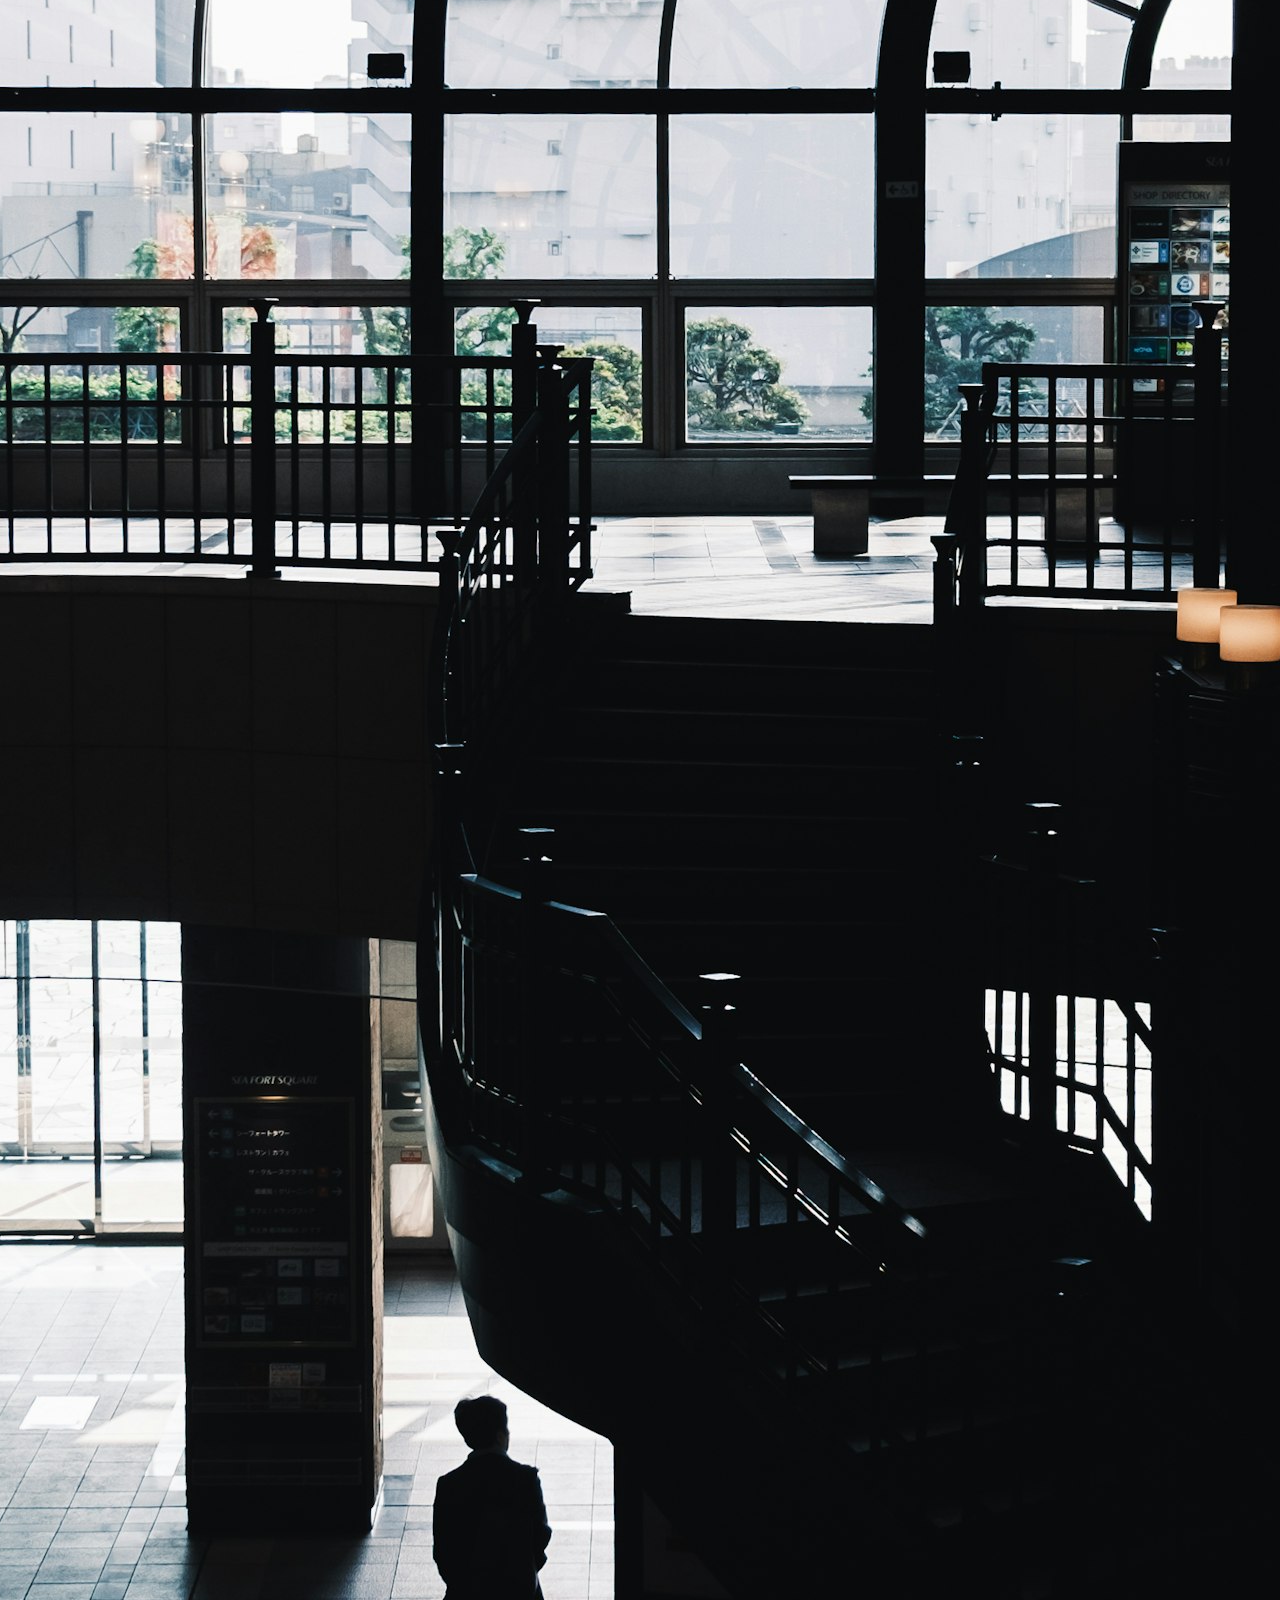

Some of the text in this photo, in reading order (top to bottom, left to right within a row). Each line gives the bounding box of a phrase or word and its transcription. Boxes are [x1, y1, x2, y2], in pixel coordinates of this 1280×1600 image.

[1133, 191, 1158, 200] SHOP
[1162, 191, 1211, 200] DIRECTORY
[249, 1075, 276, 1085] FORT
